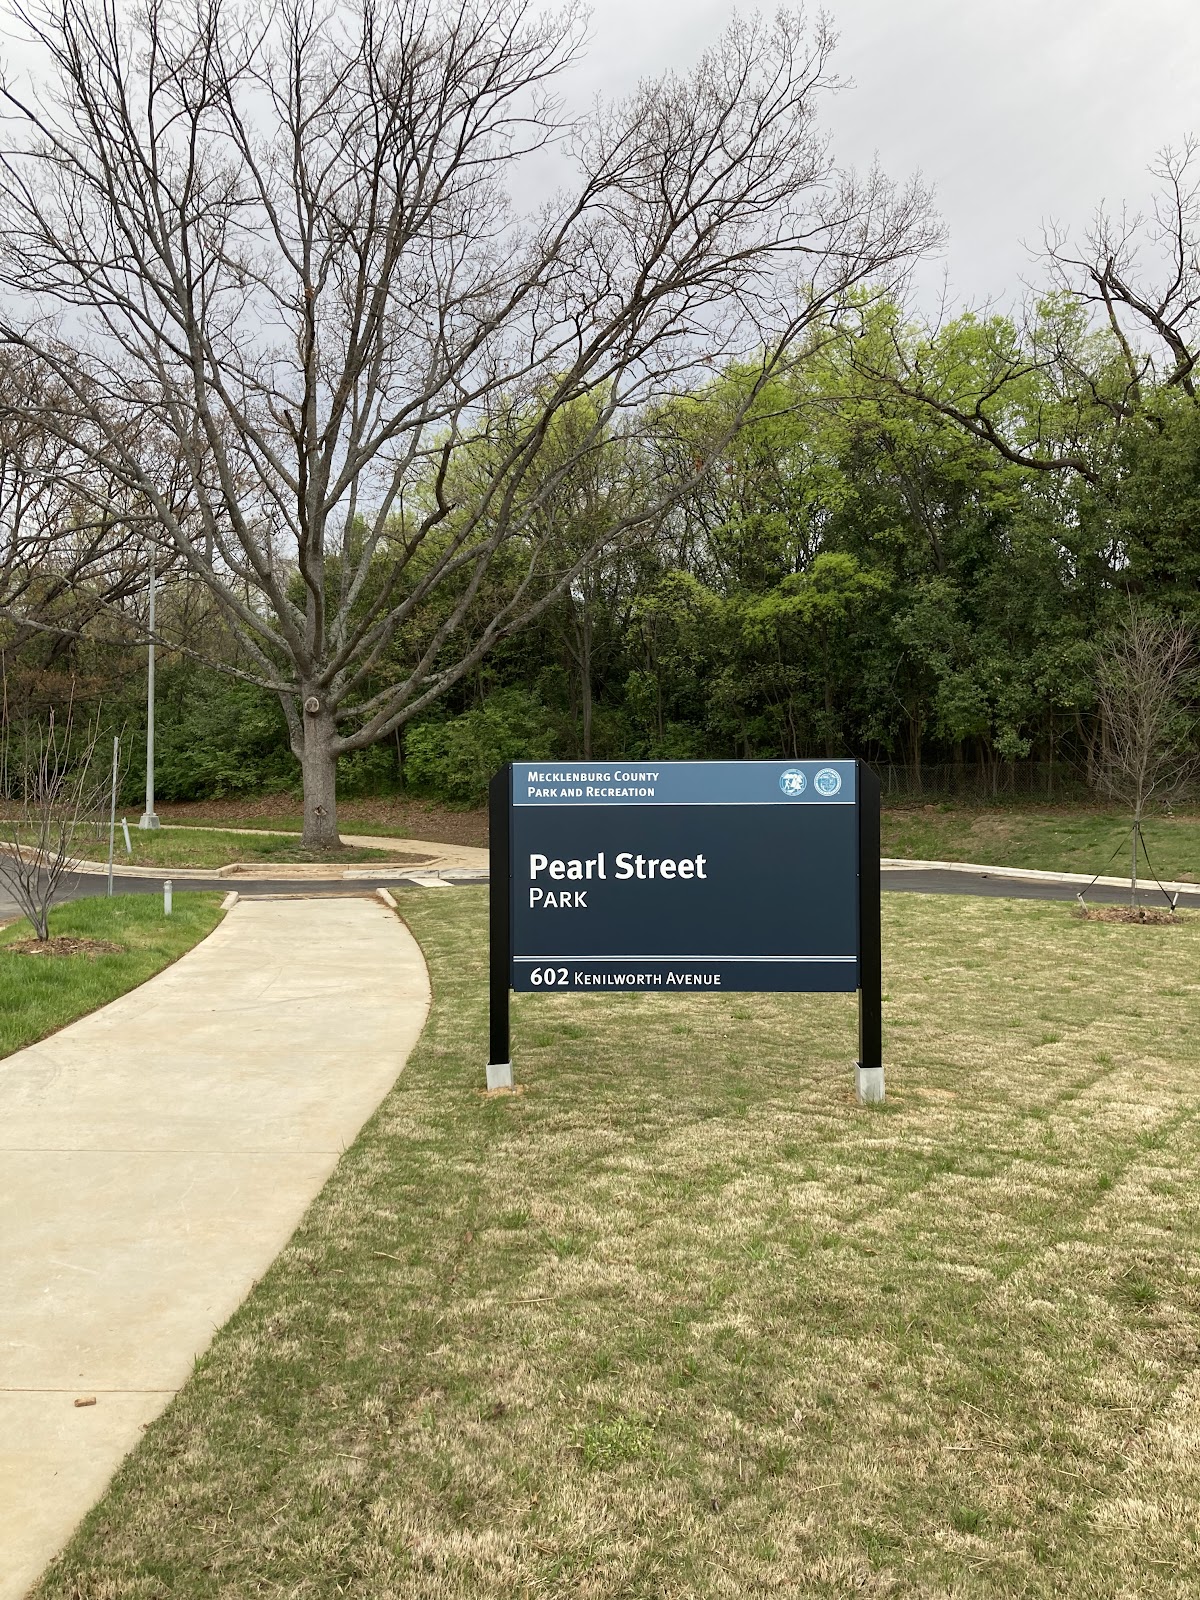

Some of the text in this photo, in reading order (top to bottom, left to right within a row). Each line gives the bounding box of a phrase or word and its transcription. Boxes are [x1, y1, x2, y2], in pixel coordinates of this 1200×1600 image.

[527, 770, 660, 782] MECKLENBURG COUNTY
[527, 786, 655, 798] PARK AND RECREATION
[529, 852, 708, 881] Pearl Street
[529, 888, 588, 909] PARK
[530, 967, 721, 986] 602 KENILWORTH AVENUE
